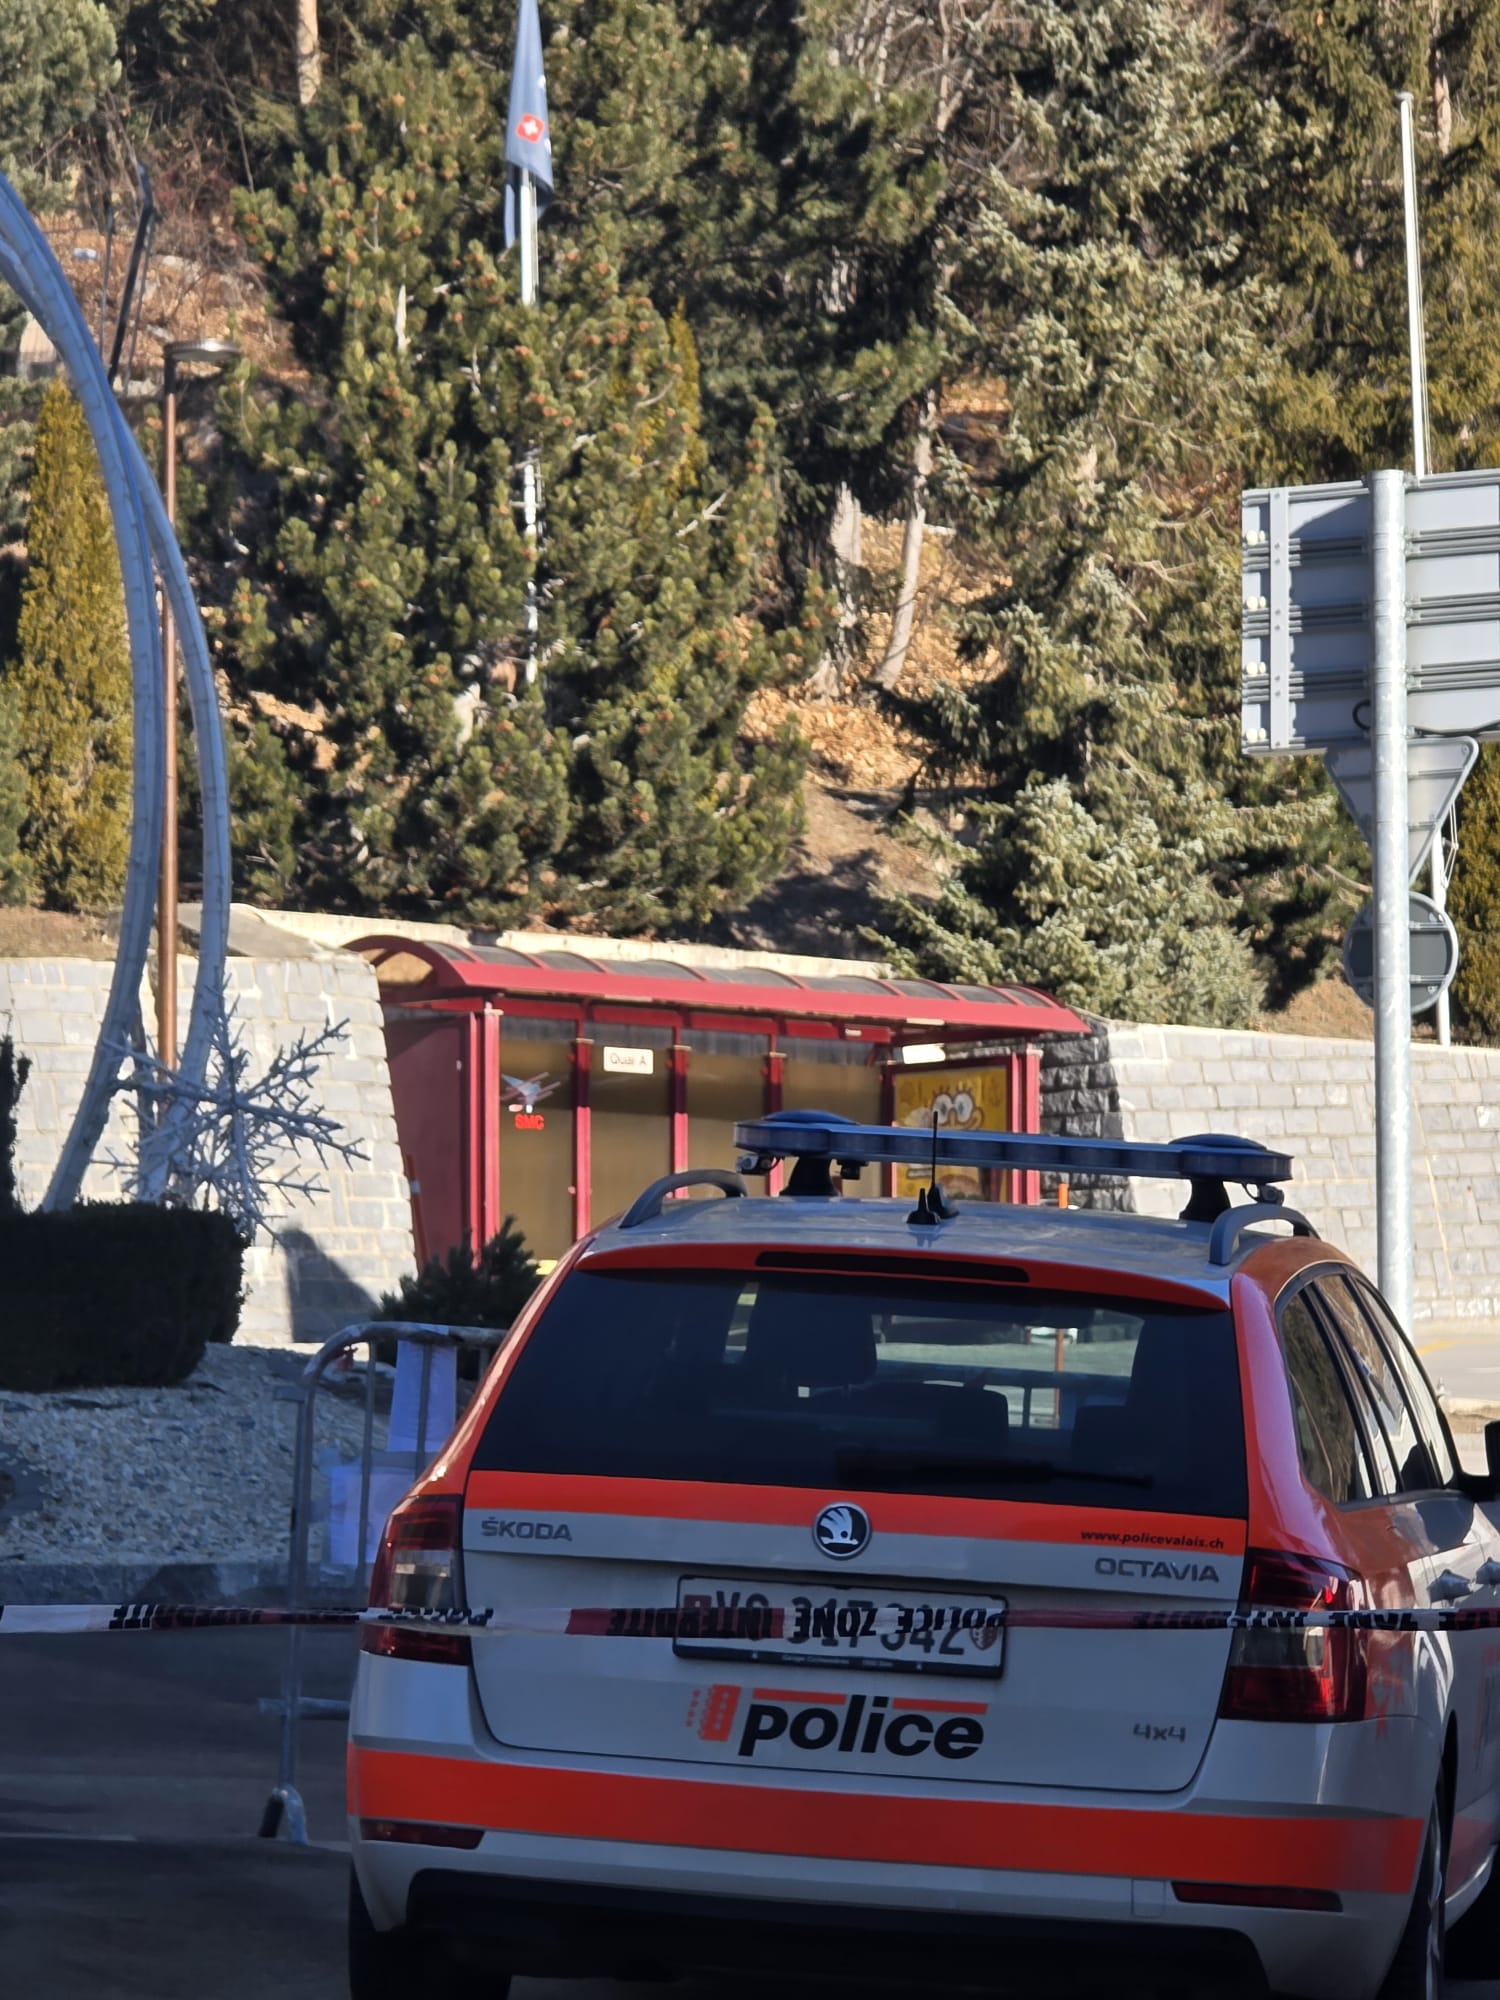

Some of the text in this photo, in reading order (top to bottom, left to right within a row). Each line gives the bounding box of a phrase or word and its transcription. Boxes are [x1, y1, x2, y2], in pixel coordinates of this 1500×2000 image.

[609, 1052, 647, 1066] Quai A
[514, 1113, 545, 1130] SMC
[481, 1516, 573, 1541] ŠKODA
[1080, 1530, 1224, 1549] www.policevalais.ch
[1094, 1557, 1220, 1583] OCTAVIA
[793, 1608, 878, 1638] ZONE
[737, 1694, 984, 1760] police
[1132, 1723, 1187, 1743] 4x4
